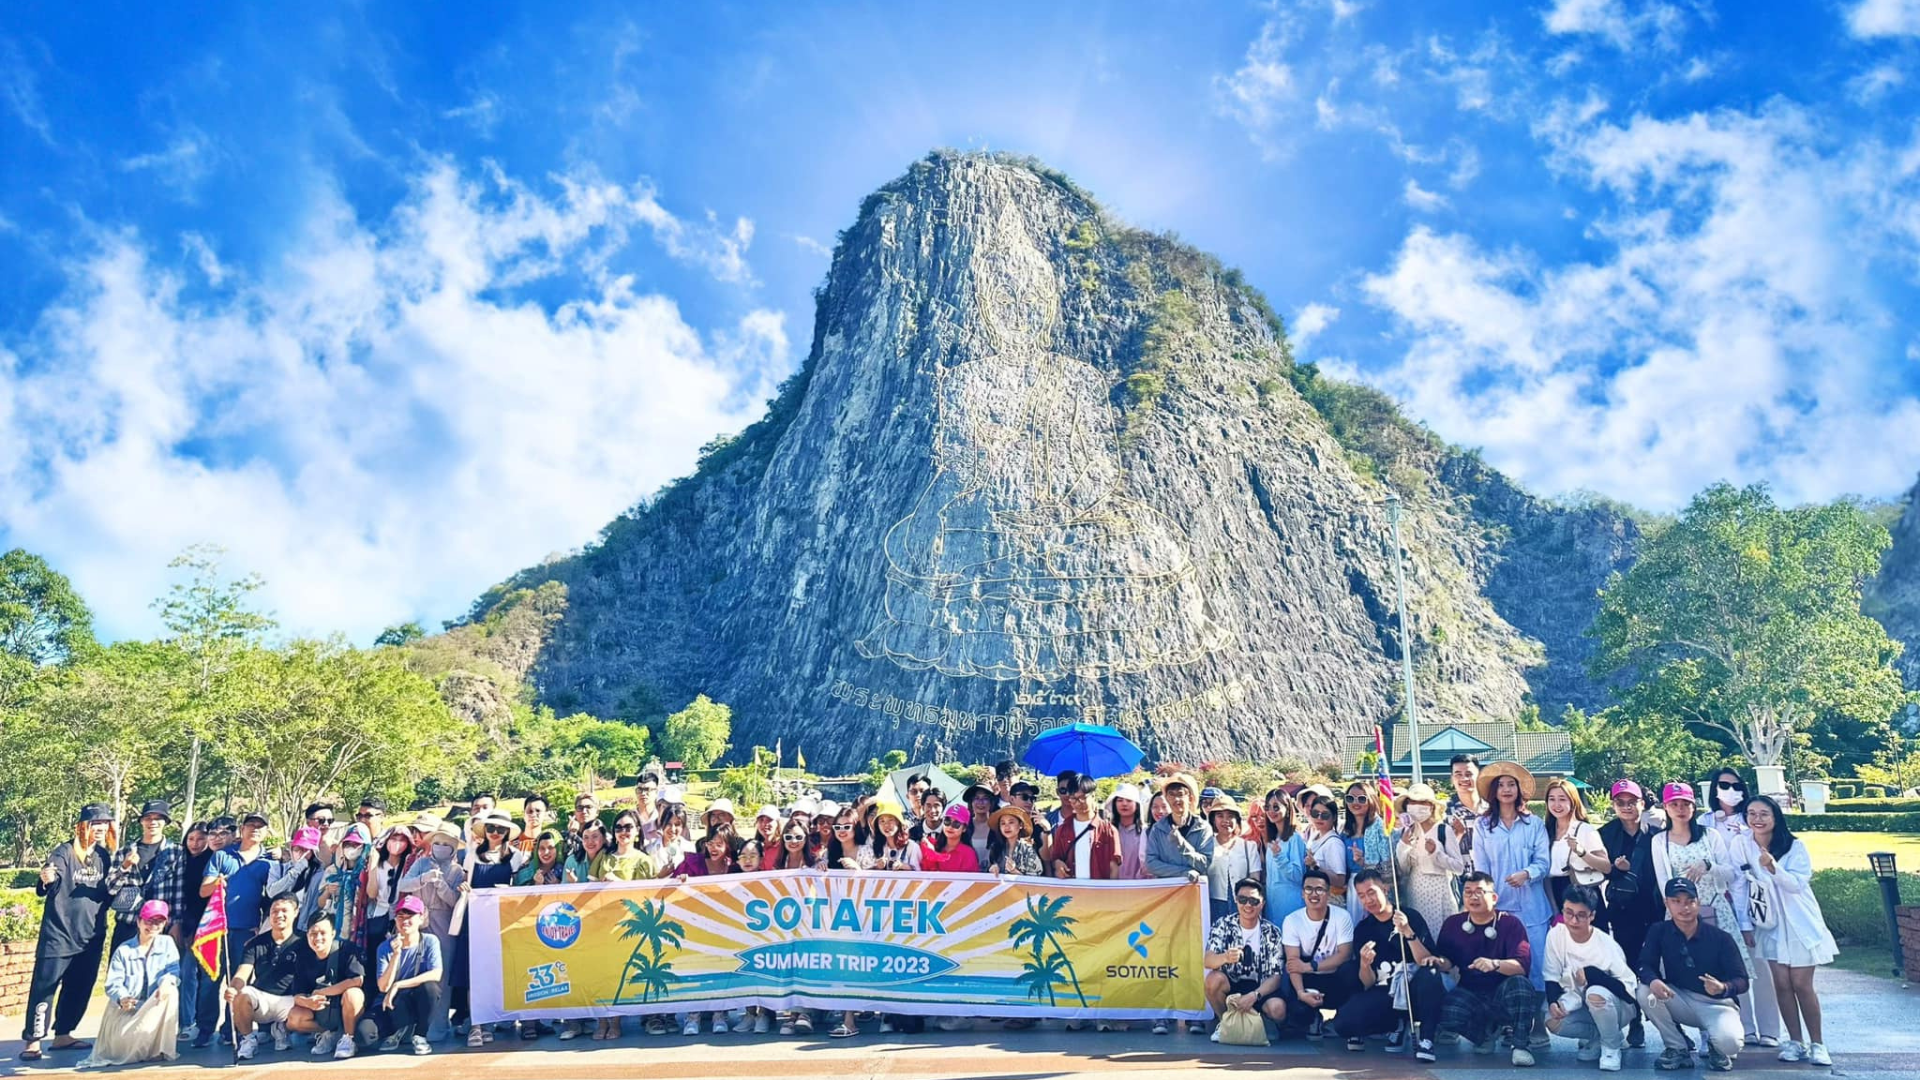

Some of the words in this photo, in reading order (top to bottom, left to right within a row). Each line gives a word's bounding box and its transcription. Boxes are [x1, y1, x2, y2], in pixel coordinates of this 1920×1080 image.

[745, 896, 948, 935] SOTATEK
[753, 952, 833, 970] SUMMER
[836, 954, 879, 972] TRIP
[882, 955, 931, 974] 2023
[1106, 965, 1180, 979] SOTATEK
